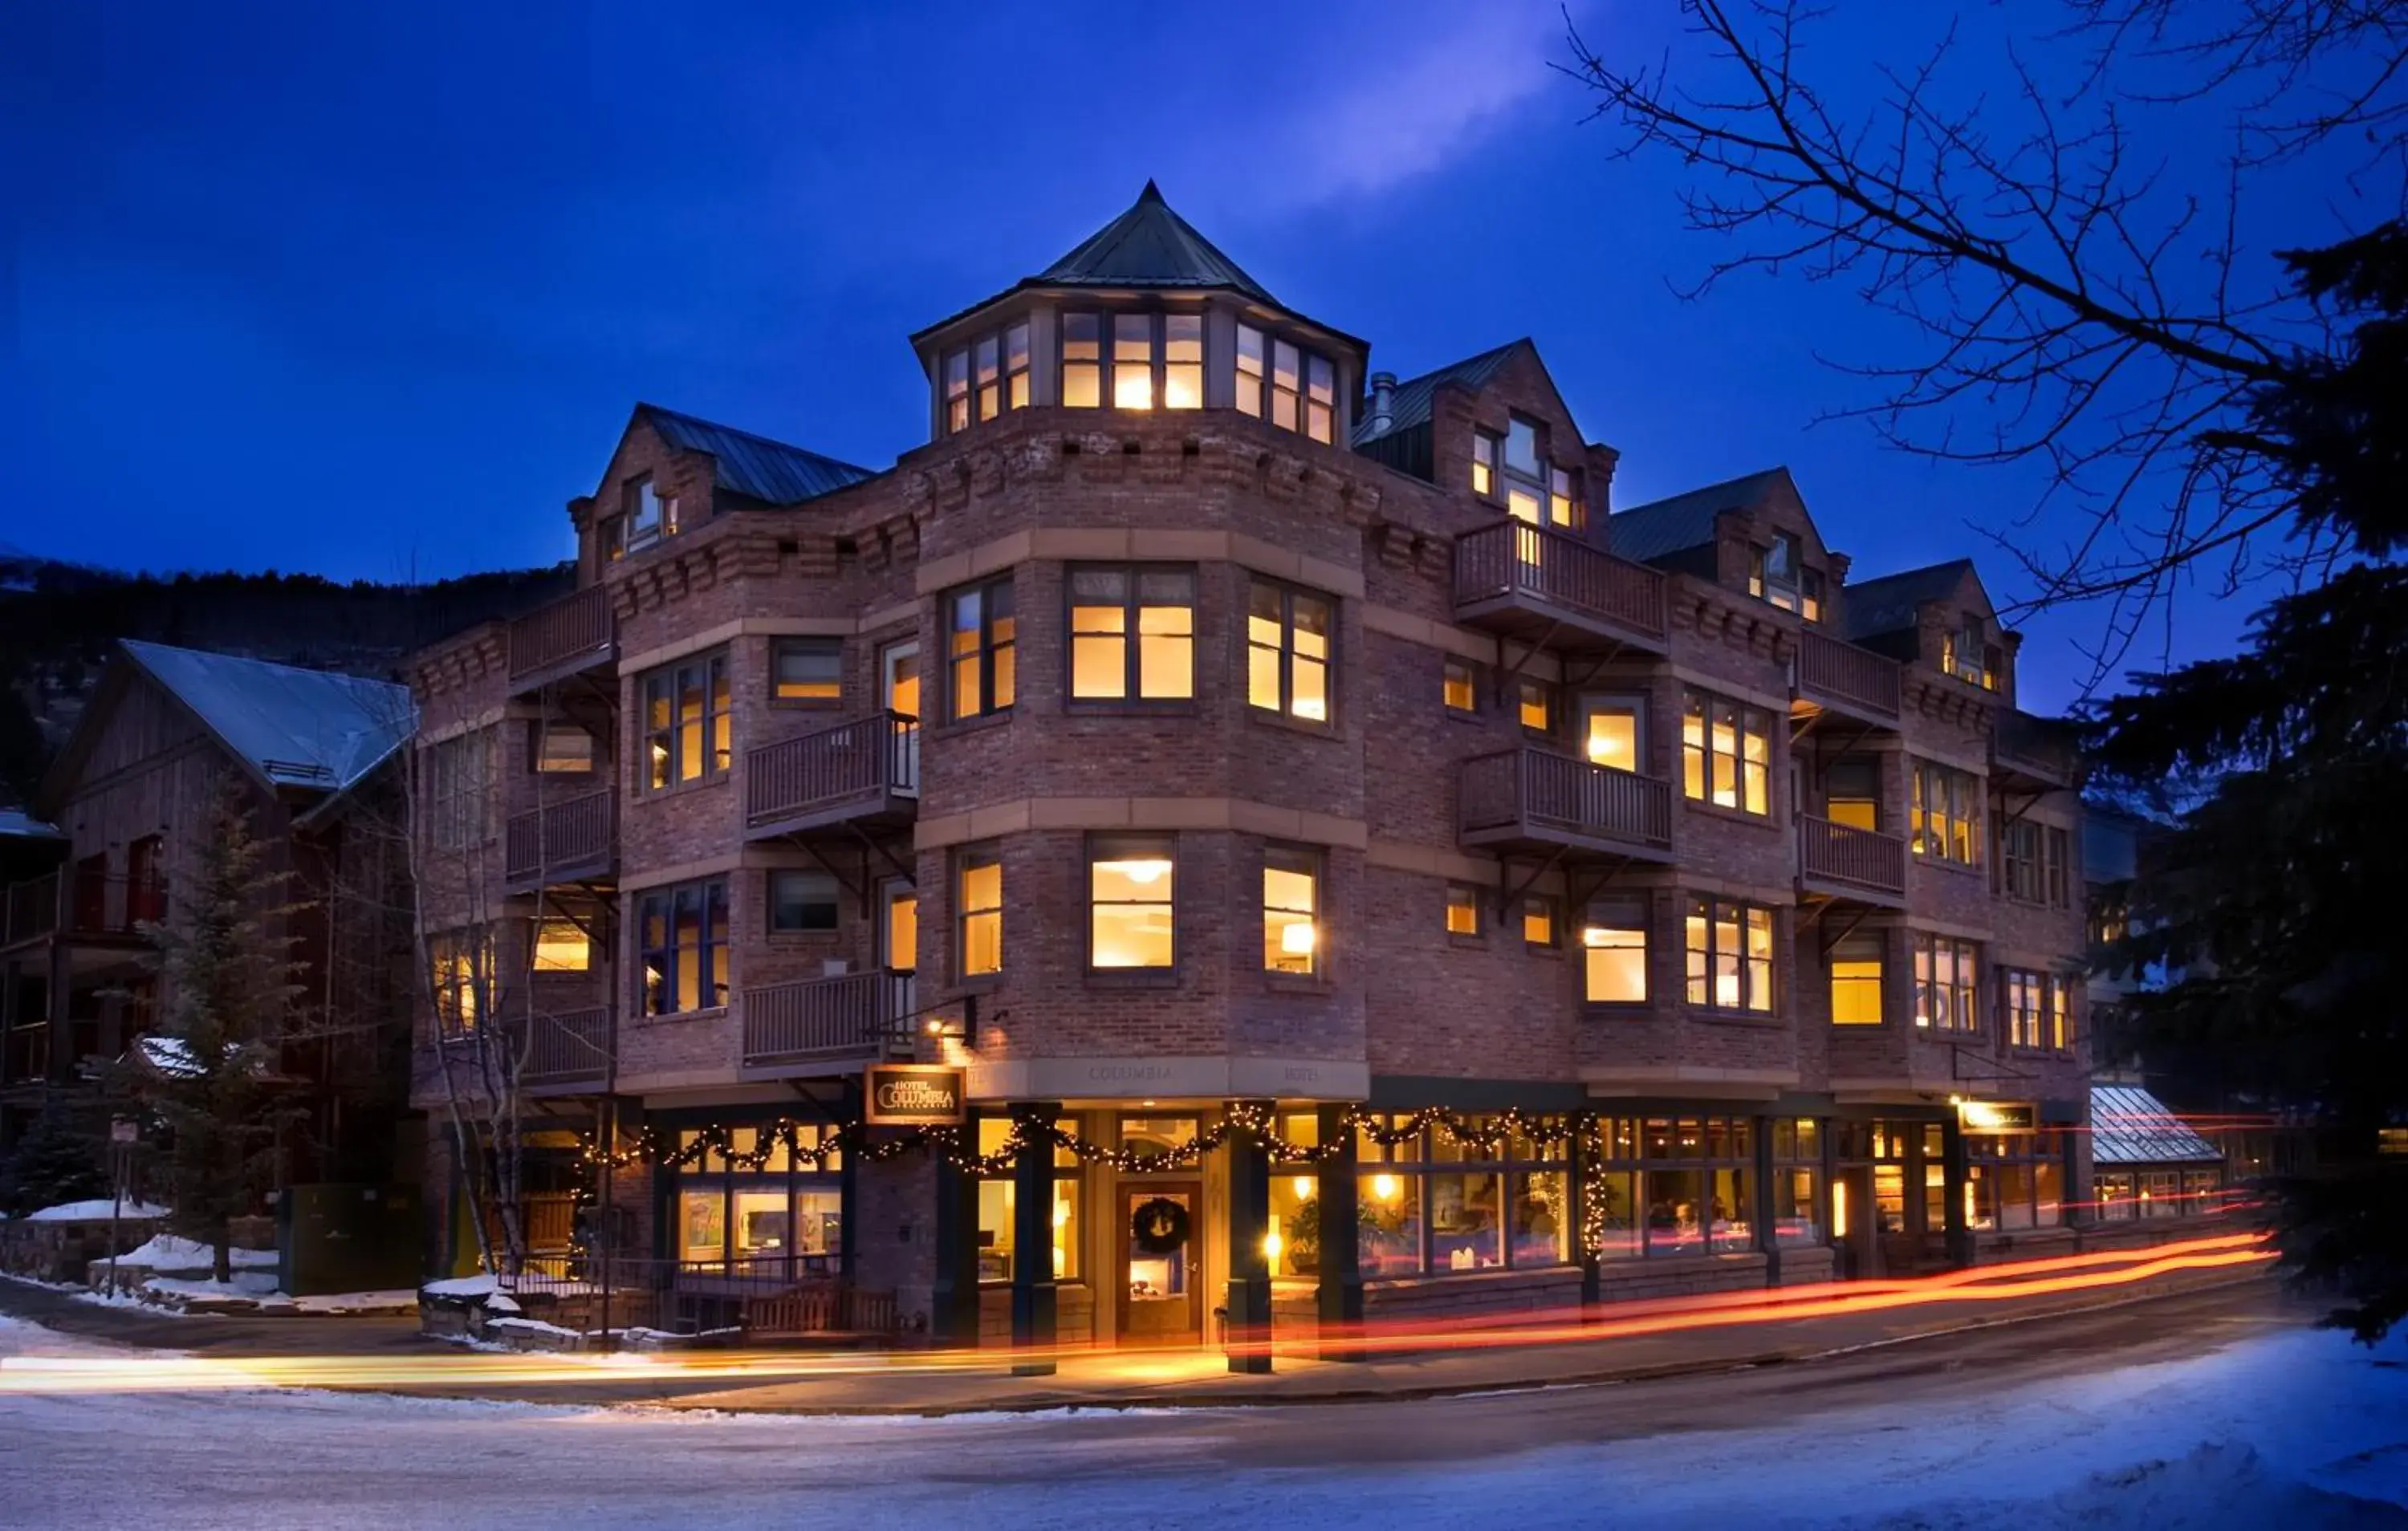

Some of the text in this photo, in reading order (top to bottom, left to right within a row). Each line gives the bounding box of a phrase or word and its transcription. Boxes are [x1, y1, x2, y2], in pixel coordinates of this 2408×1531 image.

[1088, 1066, 1171, 1081] COLUMBIA
[895, 1081, 931, 1090] HOTEL
[877, 1083, 954, 1108] COLUMBIA
